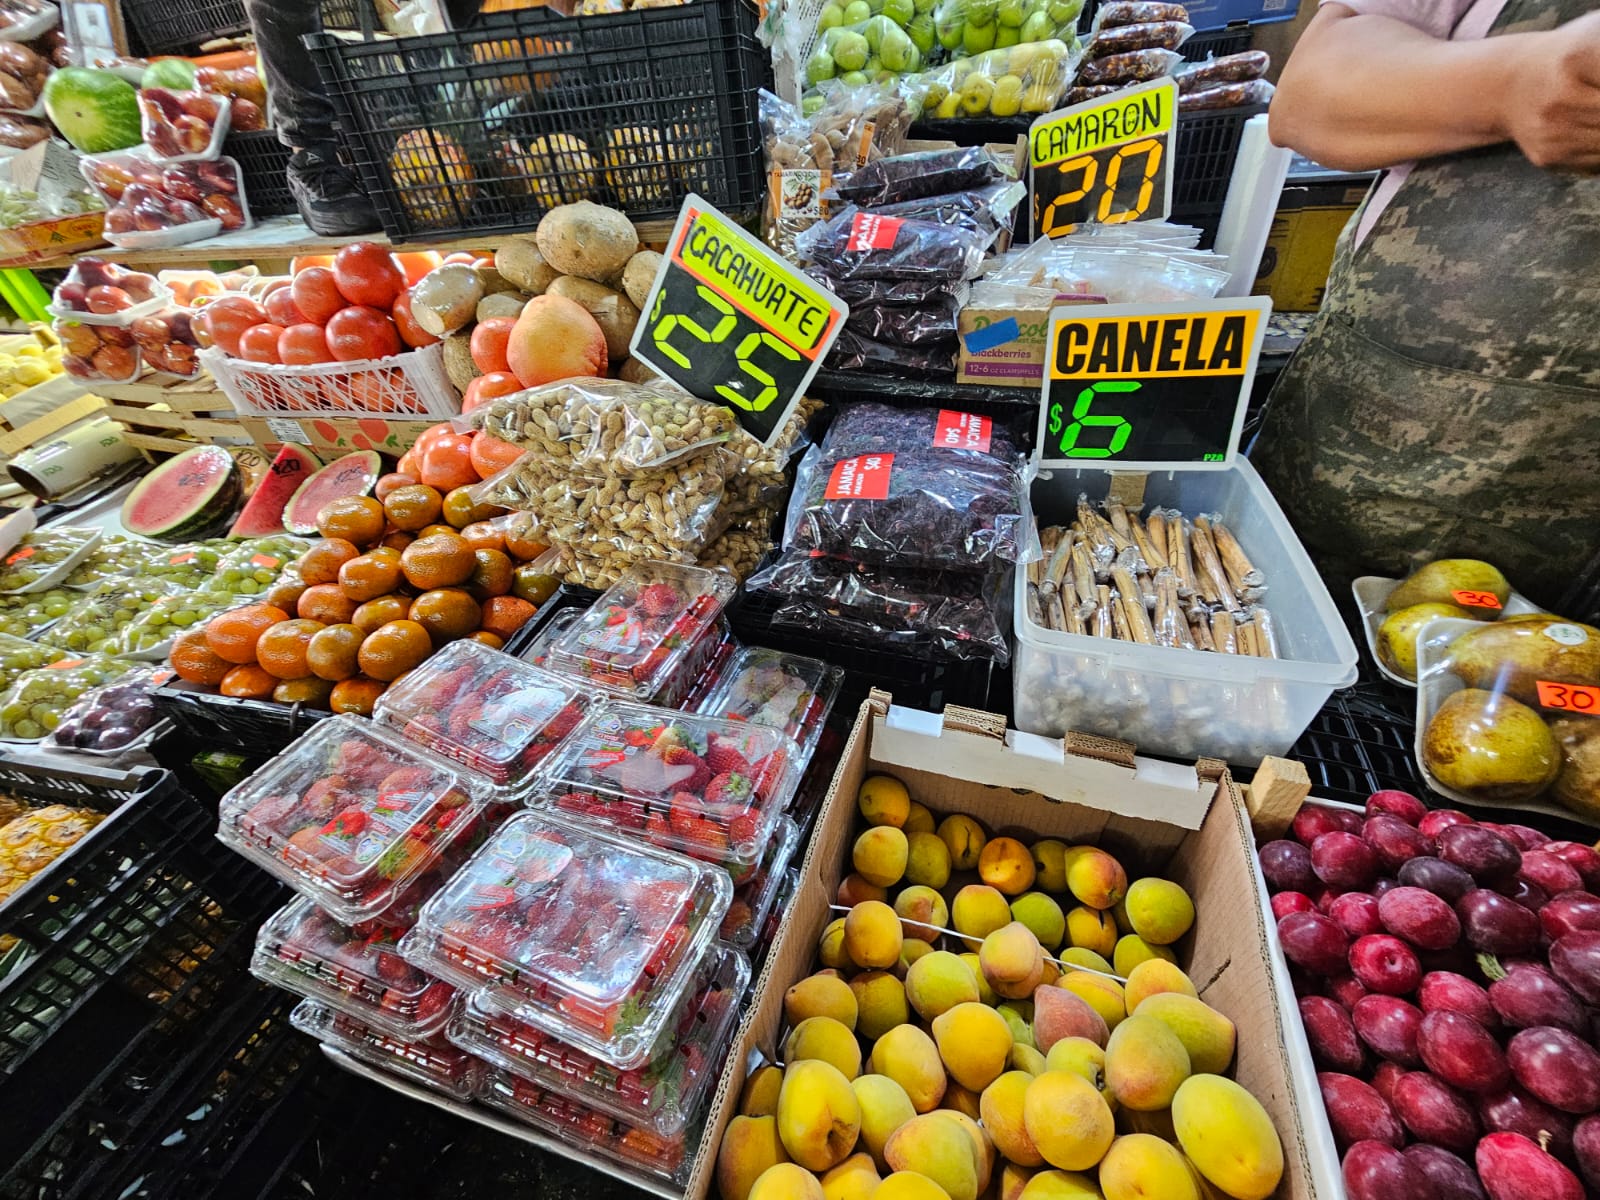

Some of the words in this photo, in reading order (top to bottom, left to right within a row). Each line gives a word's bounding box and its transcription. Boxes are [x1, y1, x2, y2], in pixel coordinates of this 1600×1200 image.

[1034, 93, 1161, 162] CAMARON
[689, 225, 822, 337] CACAHUATE
[1055, 315, 1247, 375] CANELA
[969, 364, 989, 373] 12-6
[836, 457, 859, 495] JAMAICA
[1458, 592, 1499, 606] 30
[1546, 685, 1594, 709] 30
